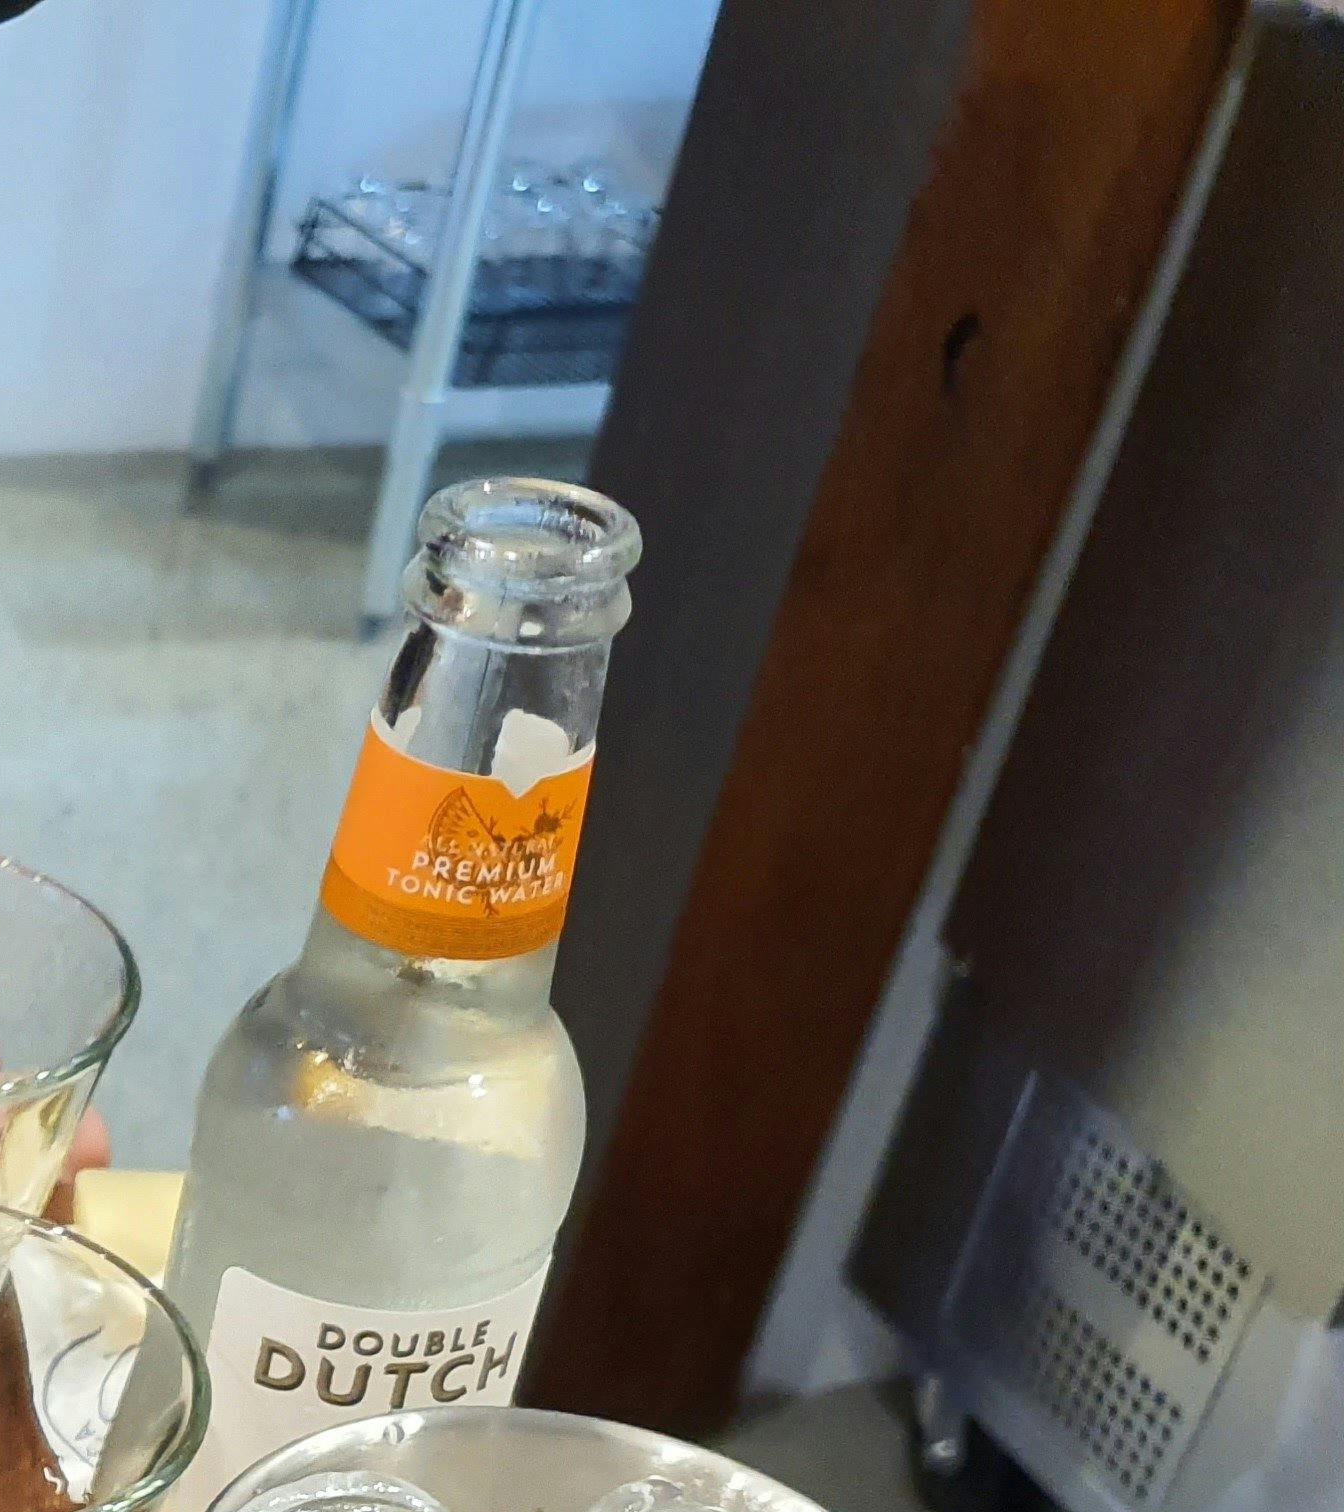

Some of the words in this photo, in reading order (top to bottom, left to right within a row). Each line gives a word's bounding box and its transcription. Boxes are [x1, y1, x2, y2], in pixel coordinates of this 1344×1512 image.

[386, 867, 477, 904] TONIC
[489, 872, 564, 904] WATER
[412, 852, 558, 884] PREMIUM
[316, 1319, 491, 1357] DOUBLE
[253, 1331, 518, 1409] DUTCH
